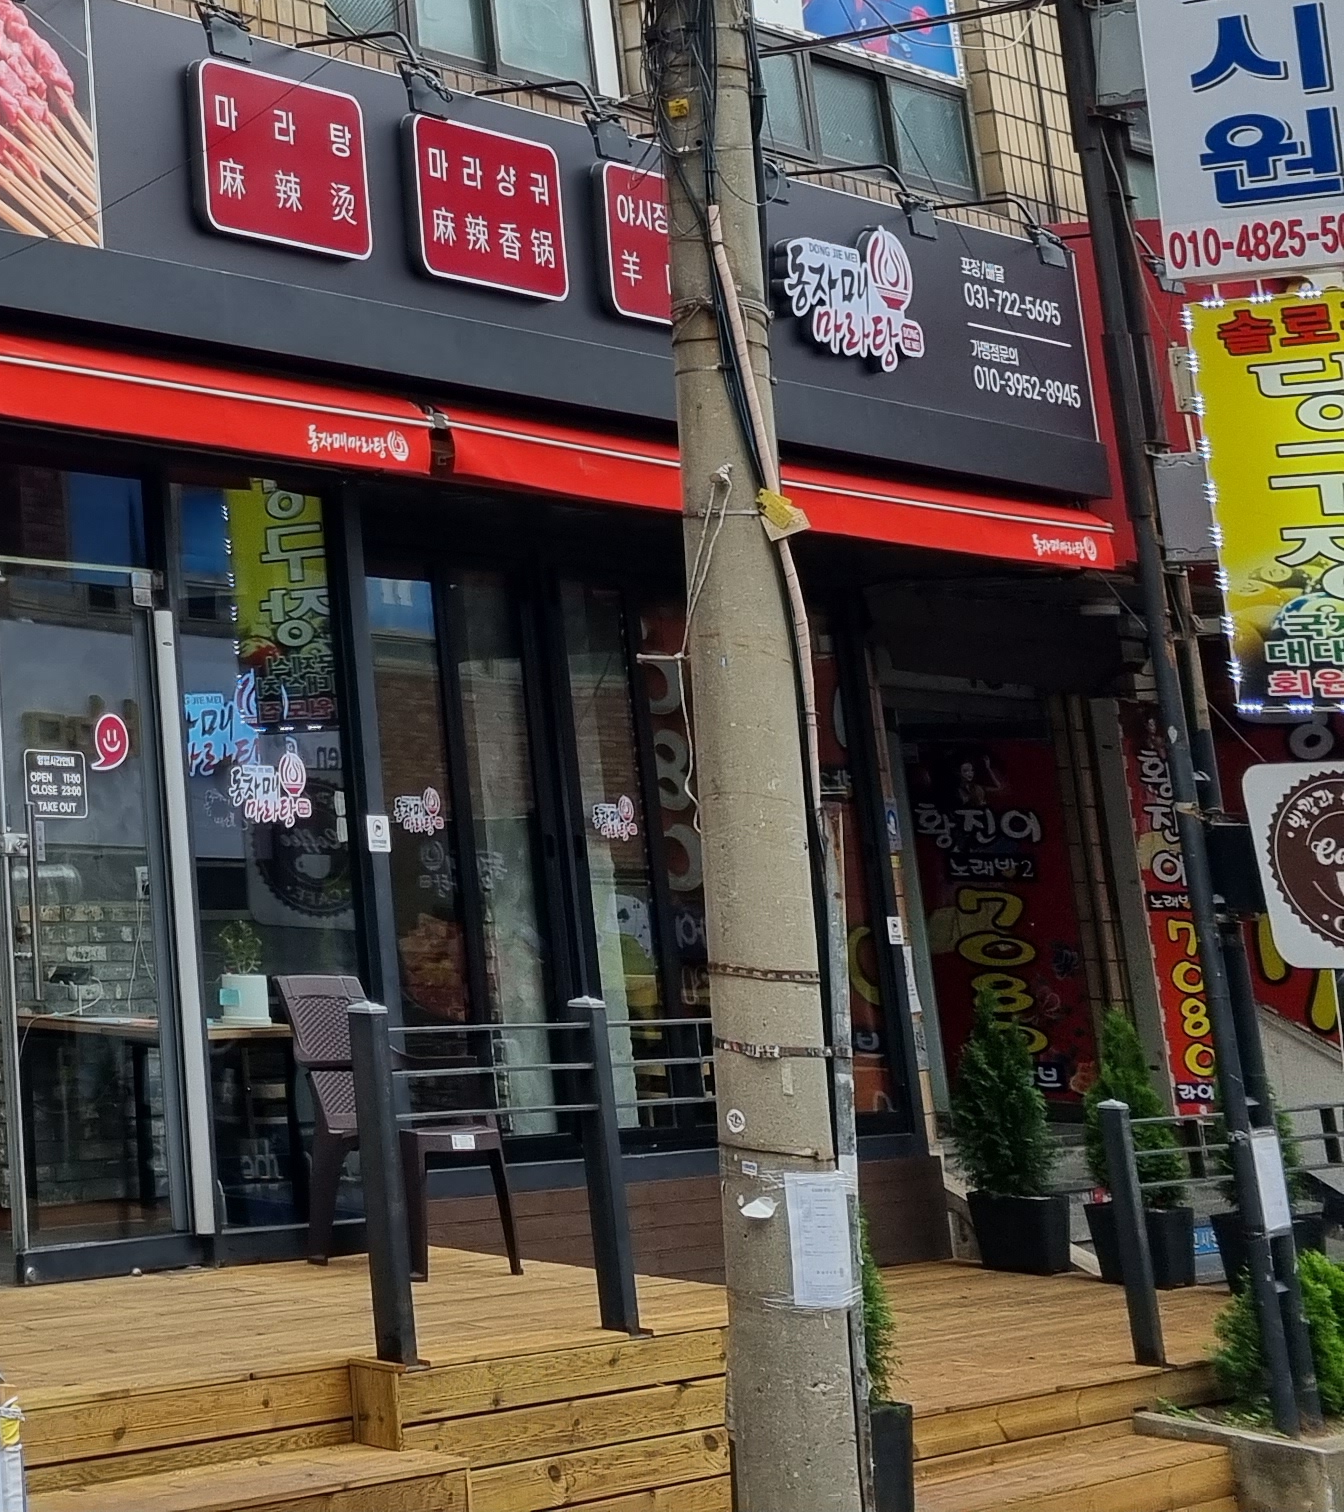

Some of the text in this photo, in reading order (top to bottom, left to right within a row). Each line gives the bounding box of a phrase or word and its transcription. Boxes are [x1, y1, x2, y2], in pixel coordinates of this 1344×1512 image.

[214, 93, 354, 159] 마라탕
[217, 156, 358, 227] 麻辣烫
[426, 146, 551, 207] 마라샹궈
[432, 206, 557, 269] 麻辣香锅
[787, 243, 870, 316] 동자매
[963, 282, 1062, 326] 031-722-5695
[815, 308, 900, 368] 마라탕
[1217, 303, 1344, 356] 솔로
[973, 364, 1082, 409] 010-3952-8945
[29, 771, 81, 785] OPEN 11:00
[30, 784, 82, 797] CLOSE 23:00
[229, 766, 280, 807] 동자매
[37, 801, 77, 813] TAKE OUT
[245, 798, 297, 828] 마라탕
